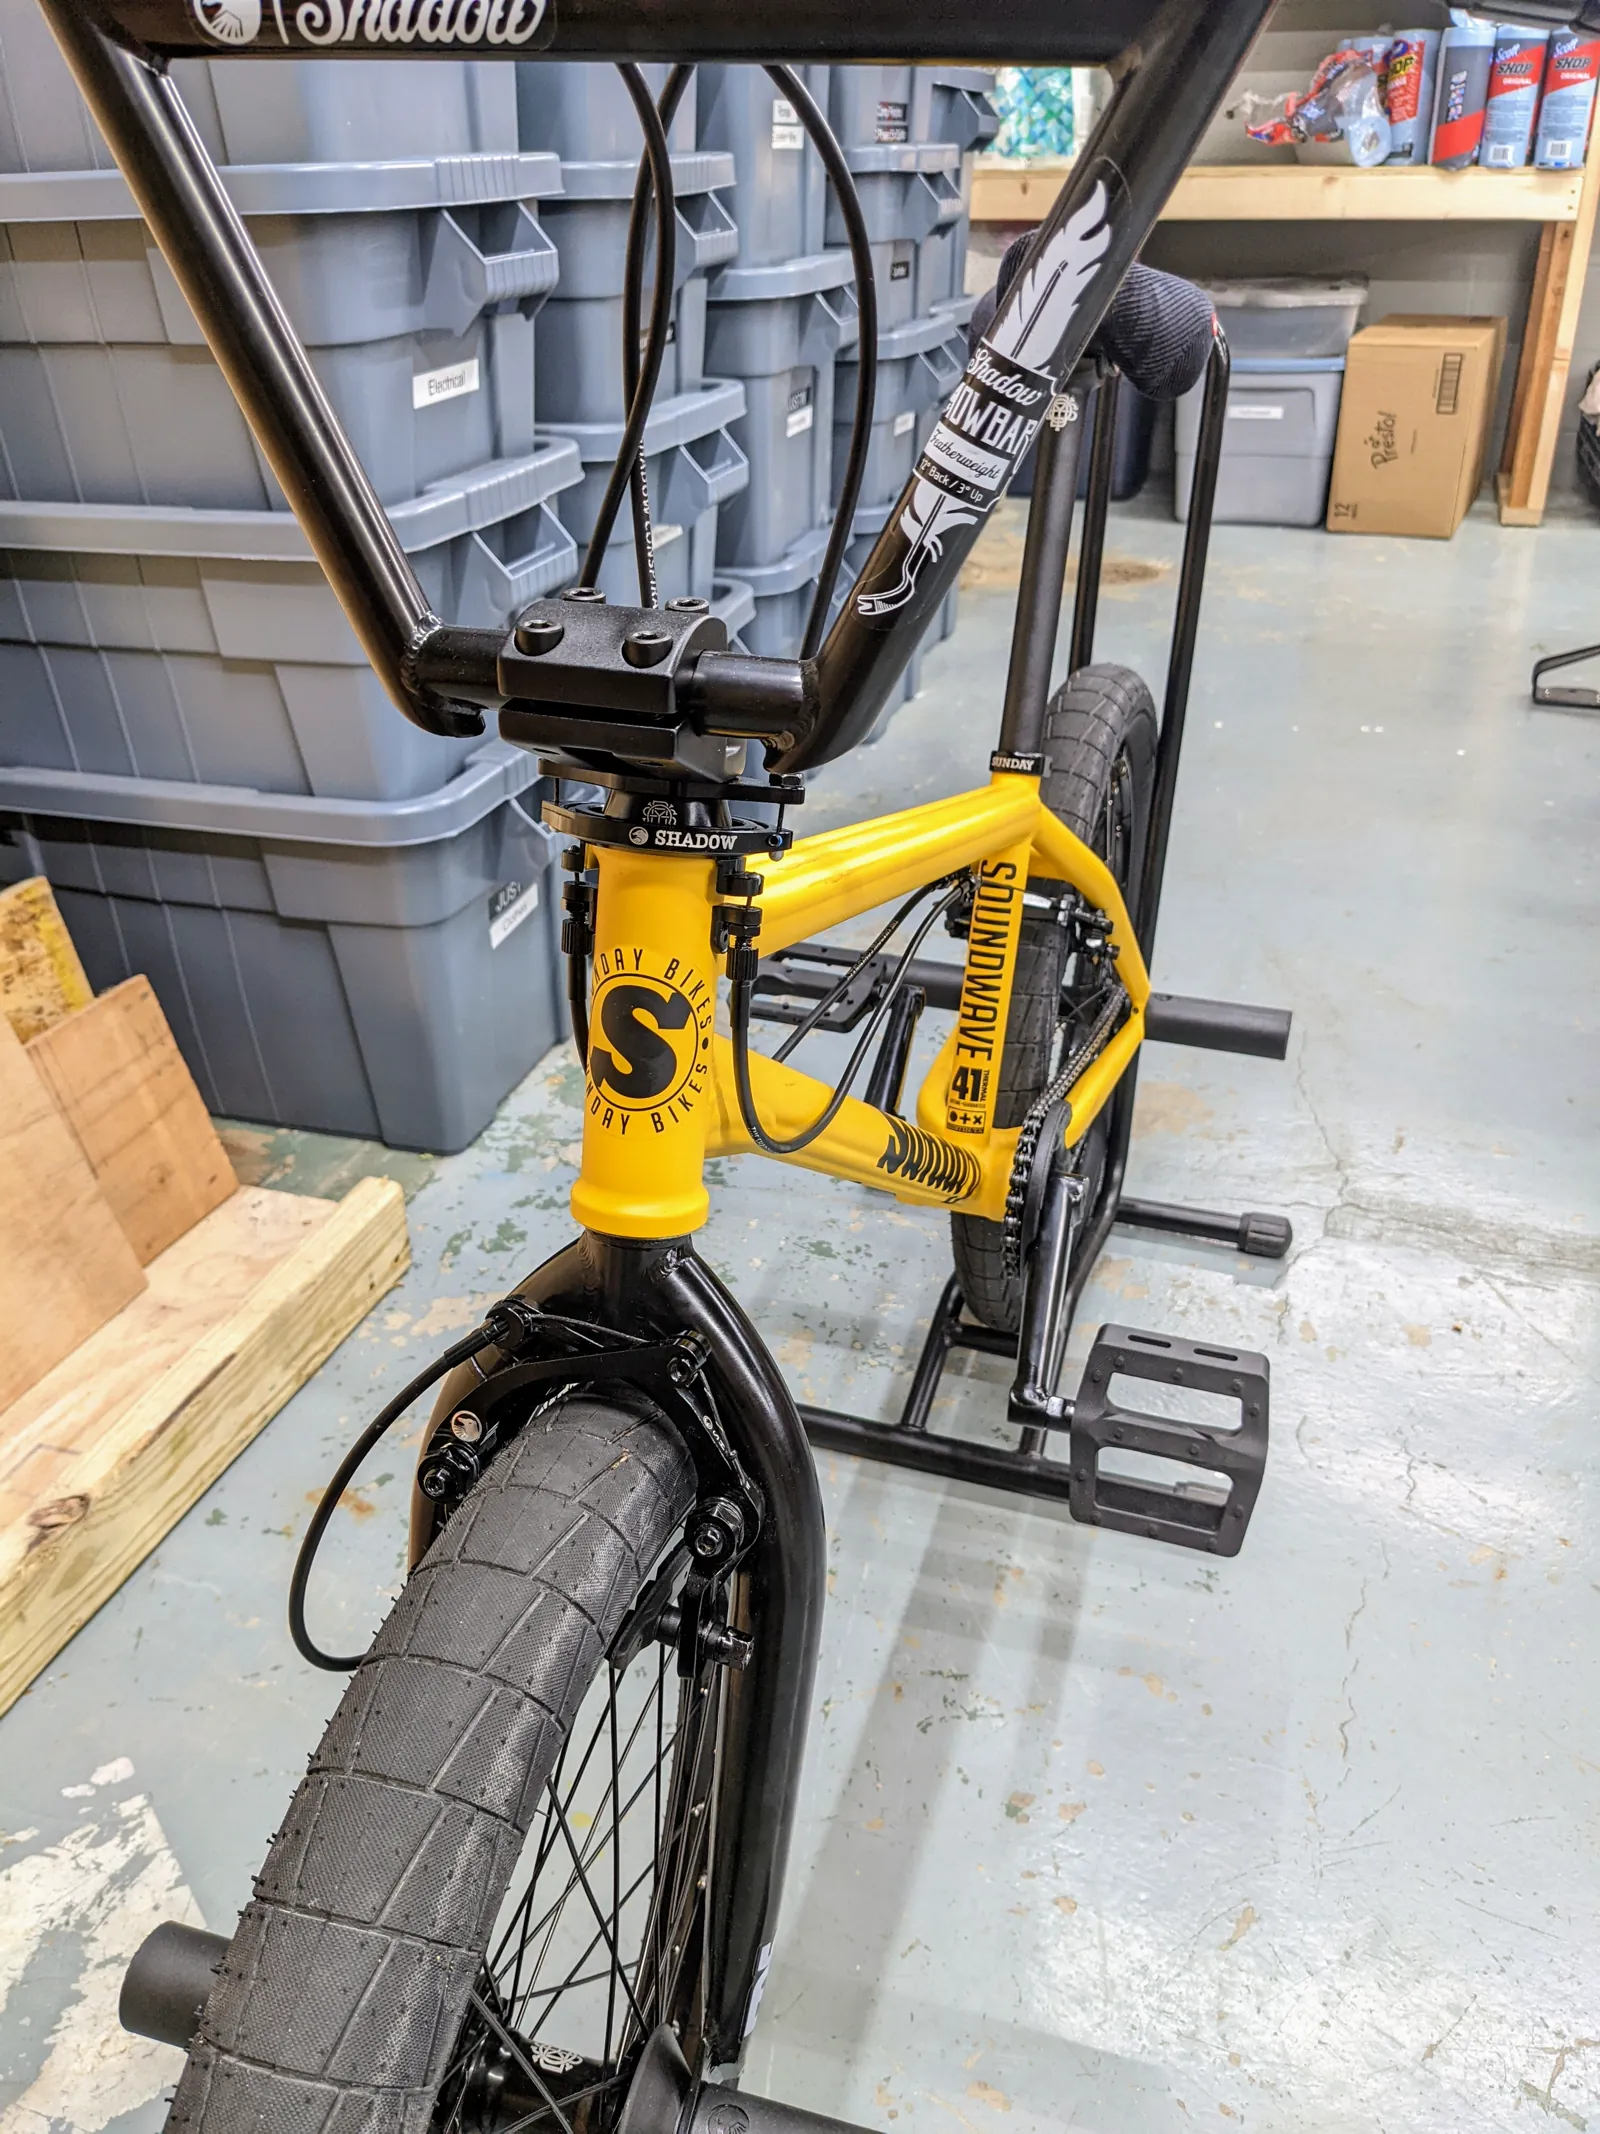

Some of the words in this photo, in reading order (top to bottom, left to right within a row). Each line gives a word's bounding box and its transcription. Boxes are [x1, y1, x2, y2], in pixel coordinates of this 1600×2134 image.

[1497, 63, 1533, 75] SHOP
[1555, 58, 1591, 69] SHOP
[428, 371, 466, 397] Electrical
[968, 348, 1042, 406] Shadow
[929, 428, 1000, 479] Featherweight
[929, 465, 949, 487] Back
[970, 491, 984, 503] Up
[1334, 502, 1350, 518] 12
[991, 755, 1035, 771] SUNDAY
[655, 829, 738, 850] SHADOW
[956, 859, 1018, 1061] SOUNDWAVE
[664, 958, 712, 1029] BIKES
[650, 1063, 708, 1133] BIKES
[951, 1066, 983, 1102] 41
[980, 1069, 990, 1102] THERMAL
